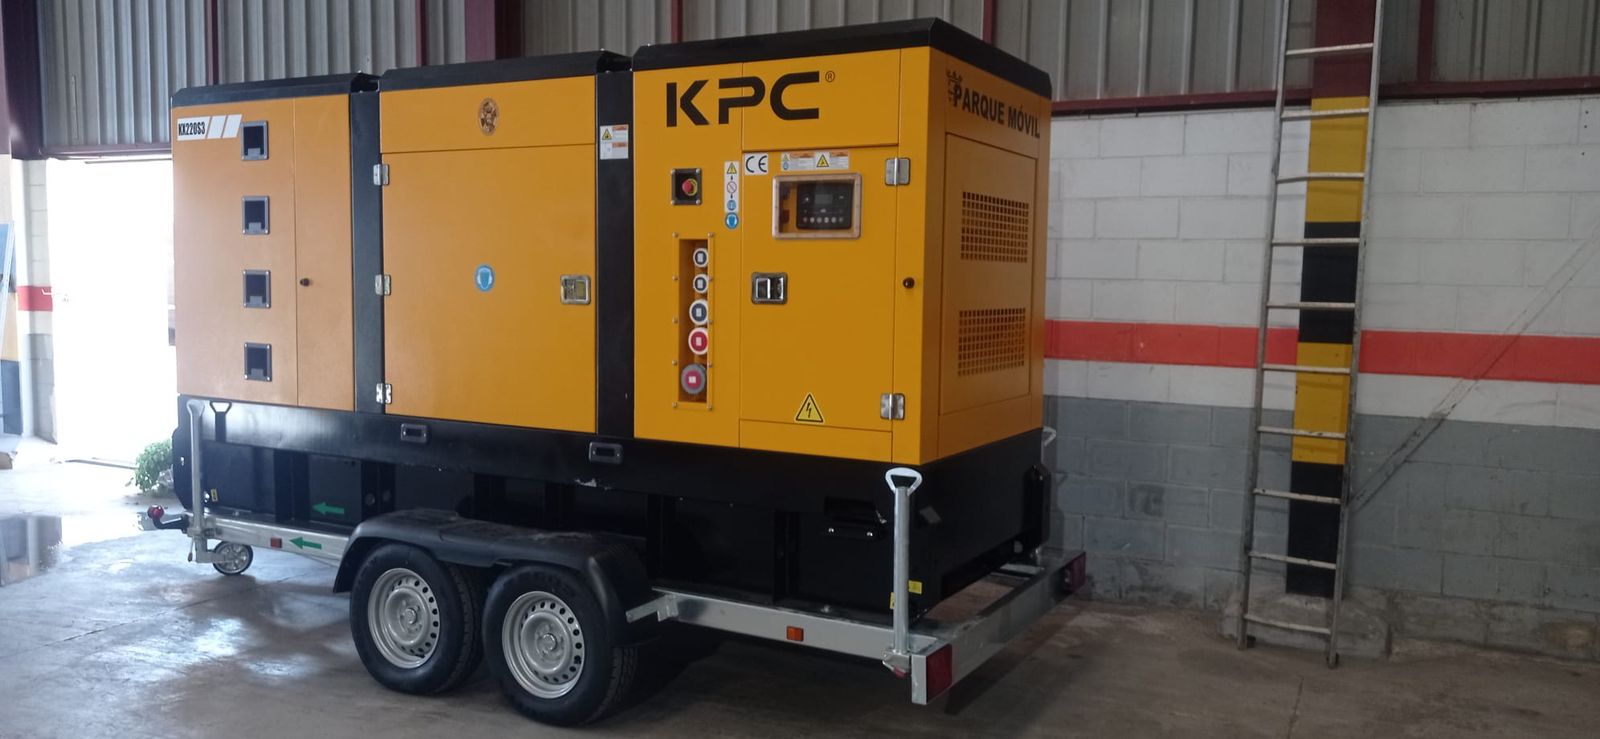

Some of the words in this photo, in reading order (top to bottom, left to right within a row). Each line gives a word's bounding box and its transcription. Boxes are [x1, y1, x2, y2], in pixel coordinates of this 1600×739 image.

[666, 71, 819, 127] KPC
[953, 82, 1005, 125] PARQUE
[1007, 104, 1040, 138] MÓVIL
[745, 155, 767, 173] CE
